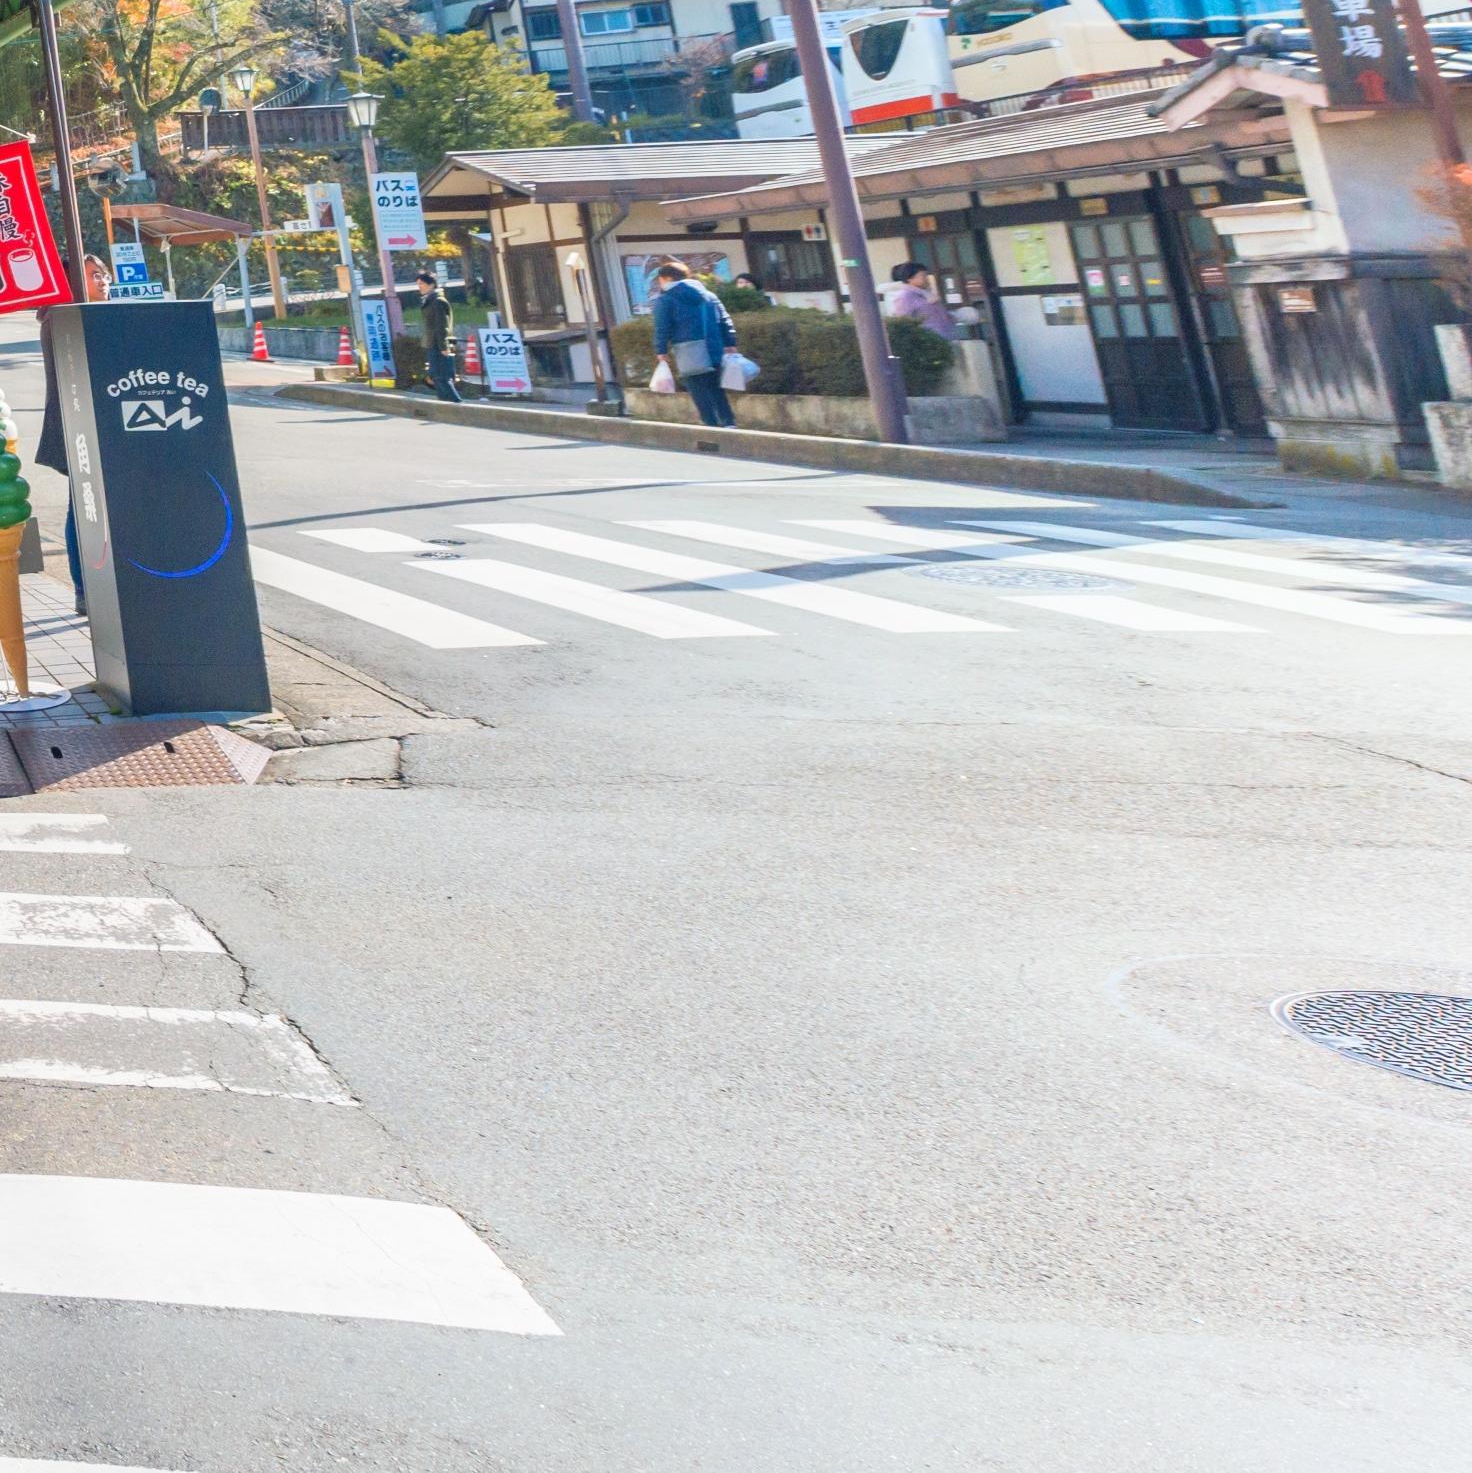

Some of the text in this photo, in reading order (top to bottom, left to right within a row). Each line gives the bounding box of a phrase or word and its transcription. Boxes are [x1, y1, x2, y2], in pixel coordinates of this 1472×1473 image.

[376, 180, 404, 191] バス
[378, 196, 418, 207] のりば
[122, 266, 135, 281] P
[485, 334, 518, 343] バス
[486, 346, 520, 355] のりば
[107, 369, 209, 398] coffee tea
